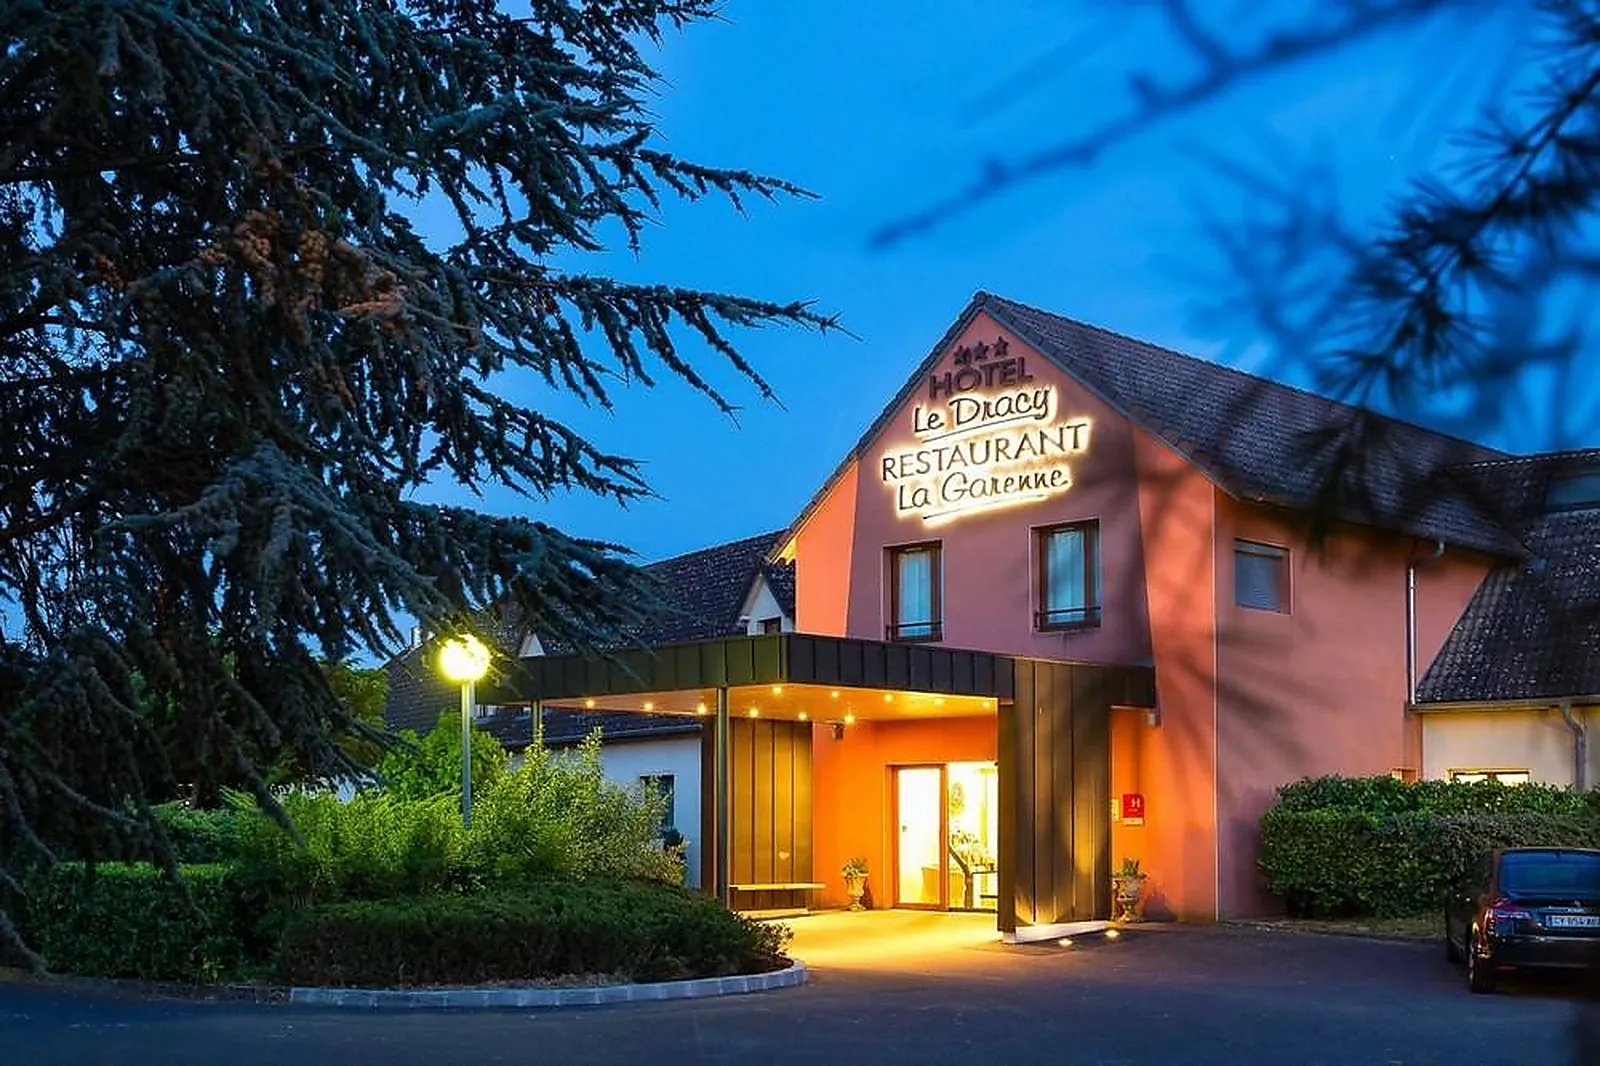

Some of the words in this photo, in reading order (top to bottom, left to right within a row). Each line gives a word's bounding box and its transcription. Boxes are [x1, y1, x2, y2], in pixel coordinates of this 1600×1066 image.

[914, 407, 944, 433] Le
[950, 388, 1051, 424] Dracy
[883, 423, 1087, 481] RESTAURANT
[899, 484, 931, 510] La
[942, 469, 1068, 502] Garenne
